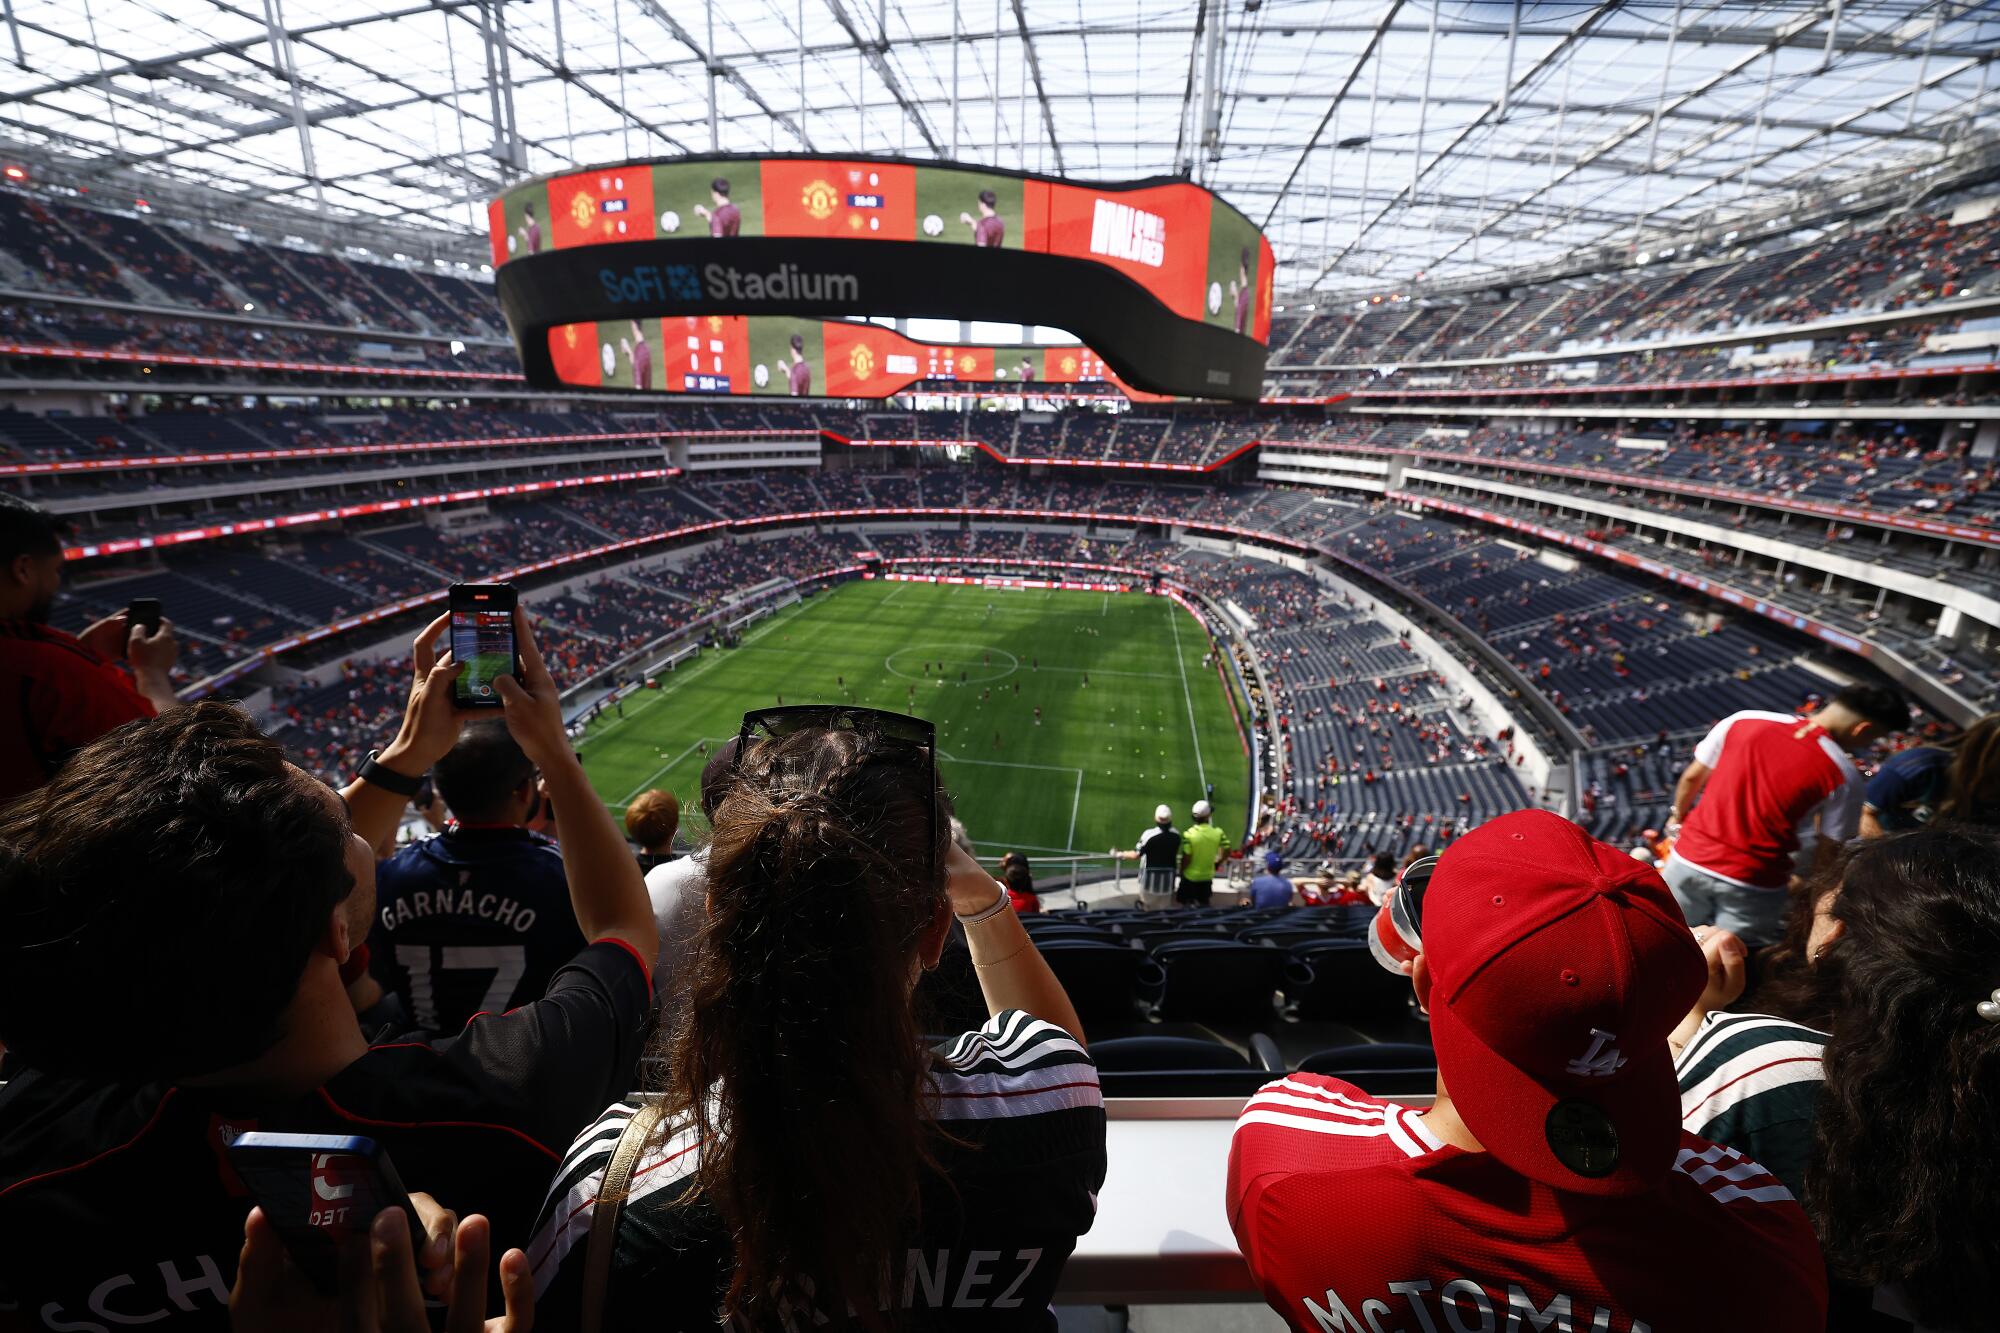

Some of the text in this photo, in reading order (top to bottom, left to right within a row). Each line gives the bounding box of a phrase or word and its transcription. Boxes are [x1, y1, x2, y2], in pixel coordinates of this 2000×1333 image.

[598, 263, 859, 304] SoFi Stadium
[381, 889, 537, 933] GARNACHO
[395, 945, 527, 1031] 17
[1566, 1028, 1629, 1077] LA
[40, 1254, 231, 1333] SCH
[885, 1248, 1043, 1310] NEZ
[1302, 1279, 1654, 1333] McTOM
